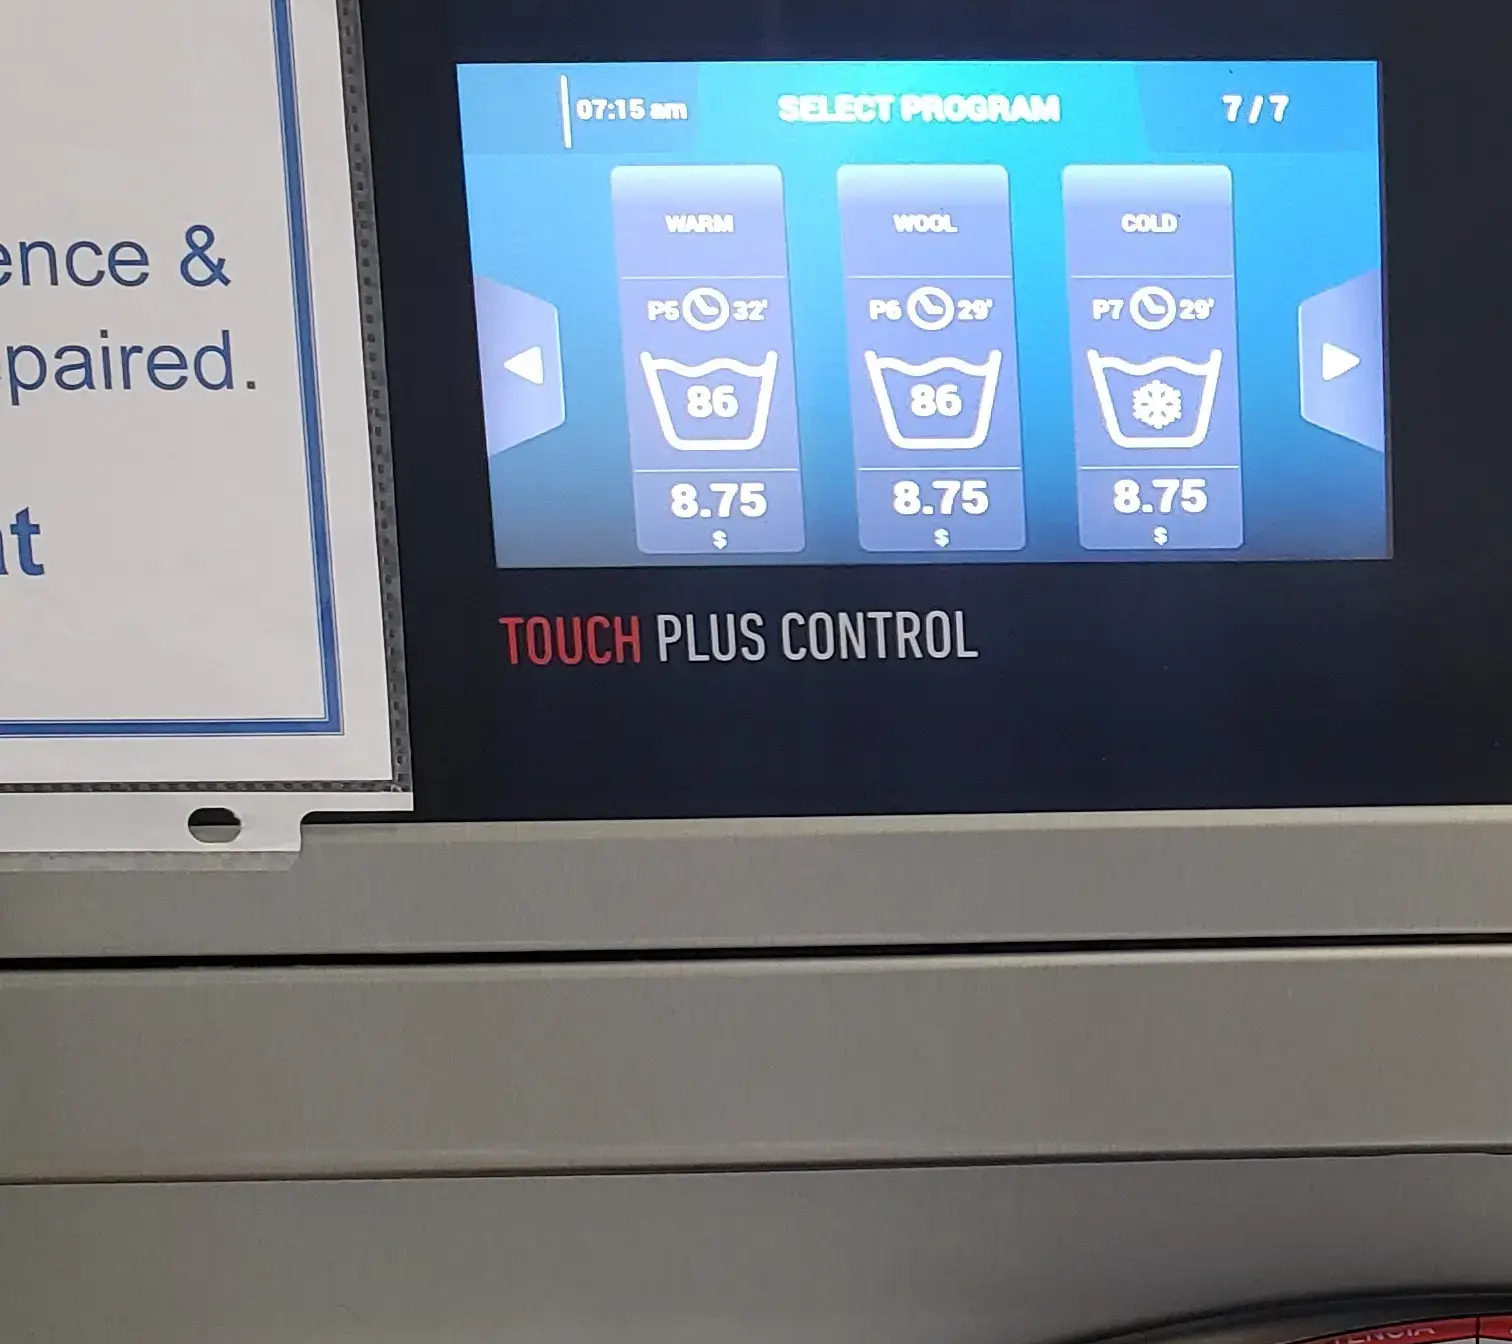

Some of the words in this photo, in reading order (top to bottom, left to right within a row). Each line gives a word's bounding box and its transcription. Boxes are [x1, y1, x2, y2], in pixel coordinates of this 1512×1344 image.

[576, 97, 646, 120] 07:15
[649, 101, 688, 120] am
[776, 93, 896, 124] SELECT
[901, 93, 1061, 124] PROGRAM
[665, 213, 735, 234] WARM
[892, 213, 959, 234] WOOL
[1120, 213, 1178, 234] COLD
[179, 223, 232, 288] &
[647, 298, 680, 321] P5
[868, 298, 902, 321] P6
[1091, 298, 1124, 321] P7
[686, 384, 739, 419] 86
[910, 383, 964, 418] 86
[669, 481, 768, 518] 8.75
[892, 479, 990, 516] 8.75
[1112, 478, 1209, 514] 8.75
[711, 529, 729, 551] $
[933, 527, 951, 549] $
[1152, 525, 1170, 547] $
[499, 615, 642, 666] TOUCH
[655, 612, 767, 663] PLUS
[781, 609, 980, 661] CONTROL
